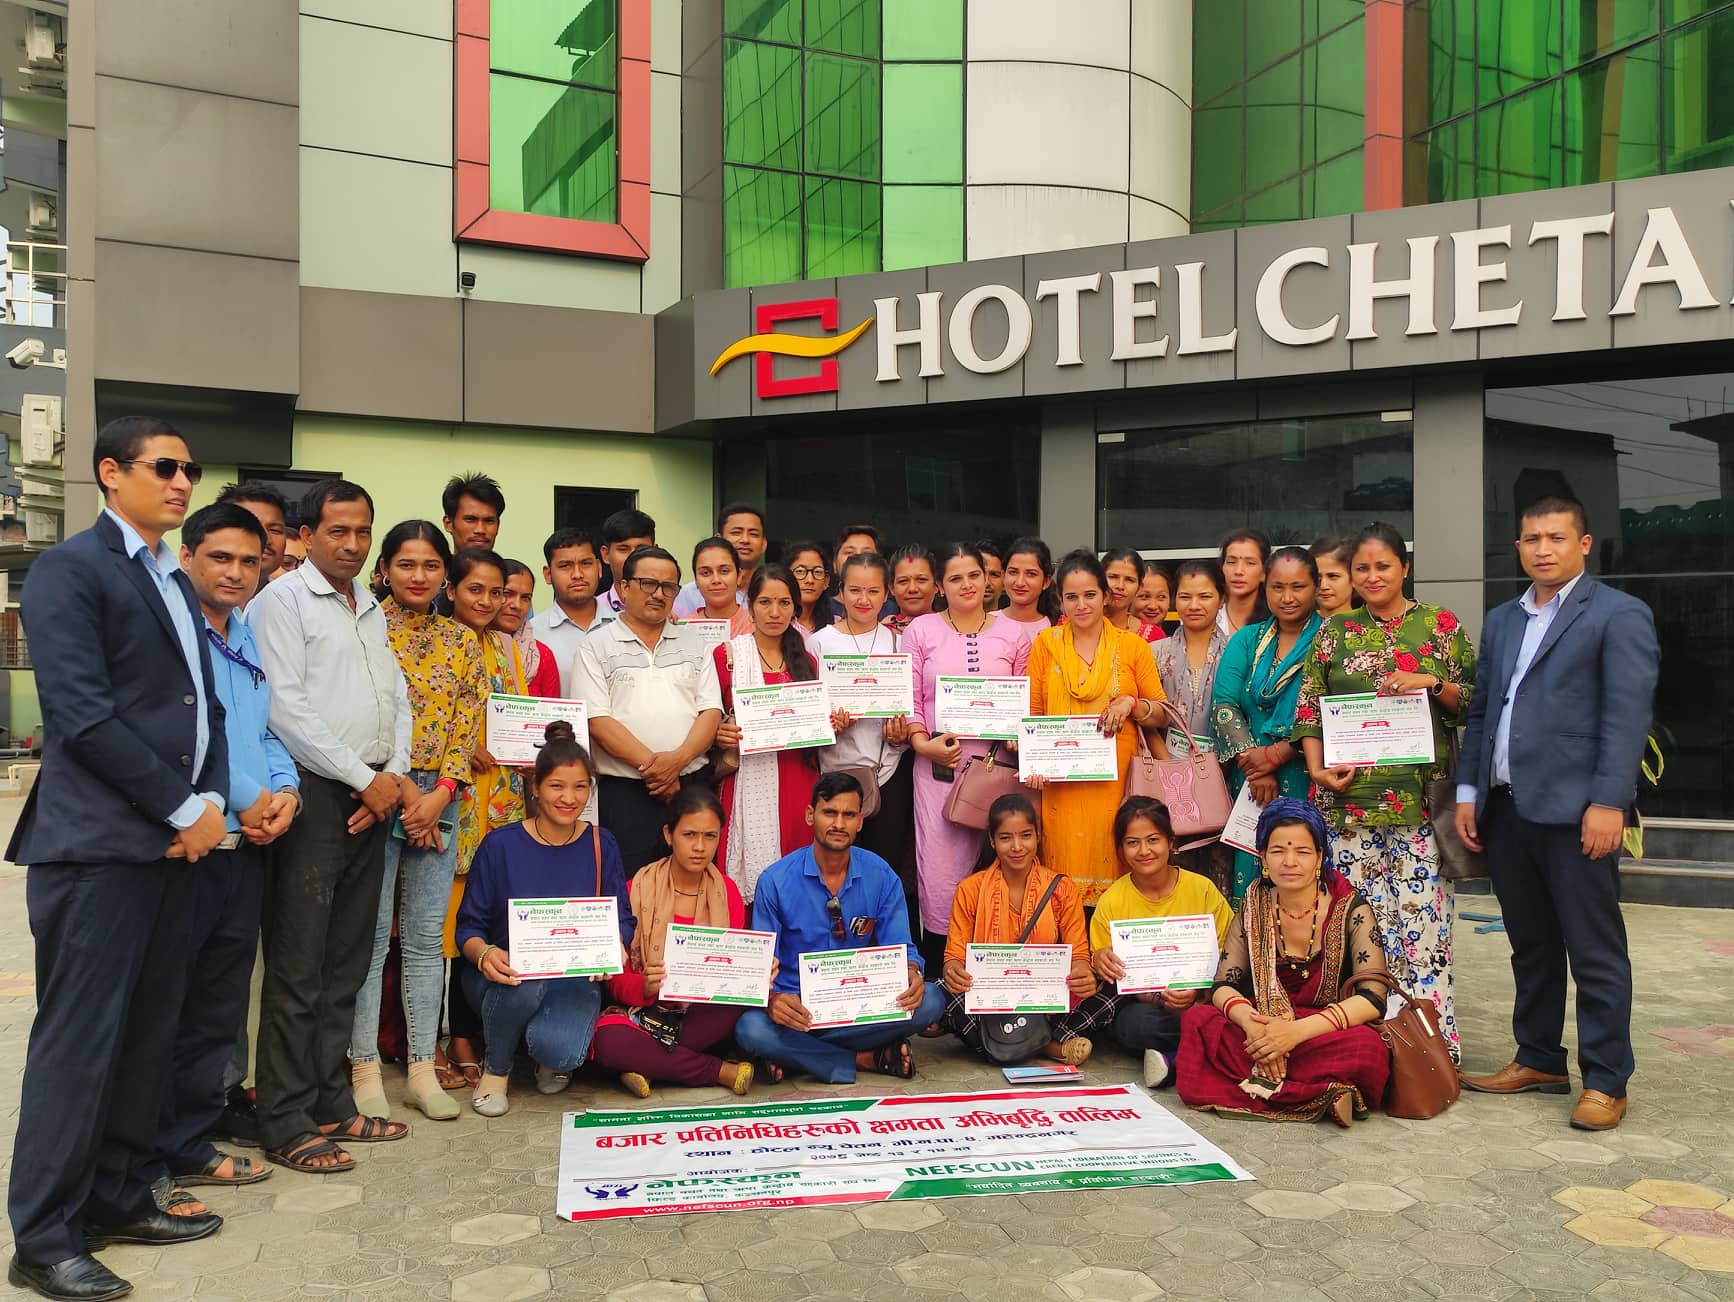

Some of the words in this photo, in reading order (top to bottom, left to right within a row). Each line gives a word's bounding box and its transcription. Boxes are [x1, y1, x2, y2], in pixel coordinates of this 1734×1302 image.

[874, 261, 1237, 382] HOTEL
[1255, 199, 1734, 344] CHETA
[595, 1132, 667, 1149] बजार
[867, 1118, 945, 1135] क्षमता
[1057, 1106, 1143, 1123] तालिम
[1067, 1155, 1126, 1163] FEDERATION
[1075, 1160, 1138, 1168] COOPERATIVE
[1139, 1157, 1179, 1165] UNIONS
[904, 1160, 1036, 1177] NEFSCUN
